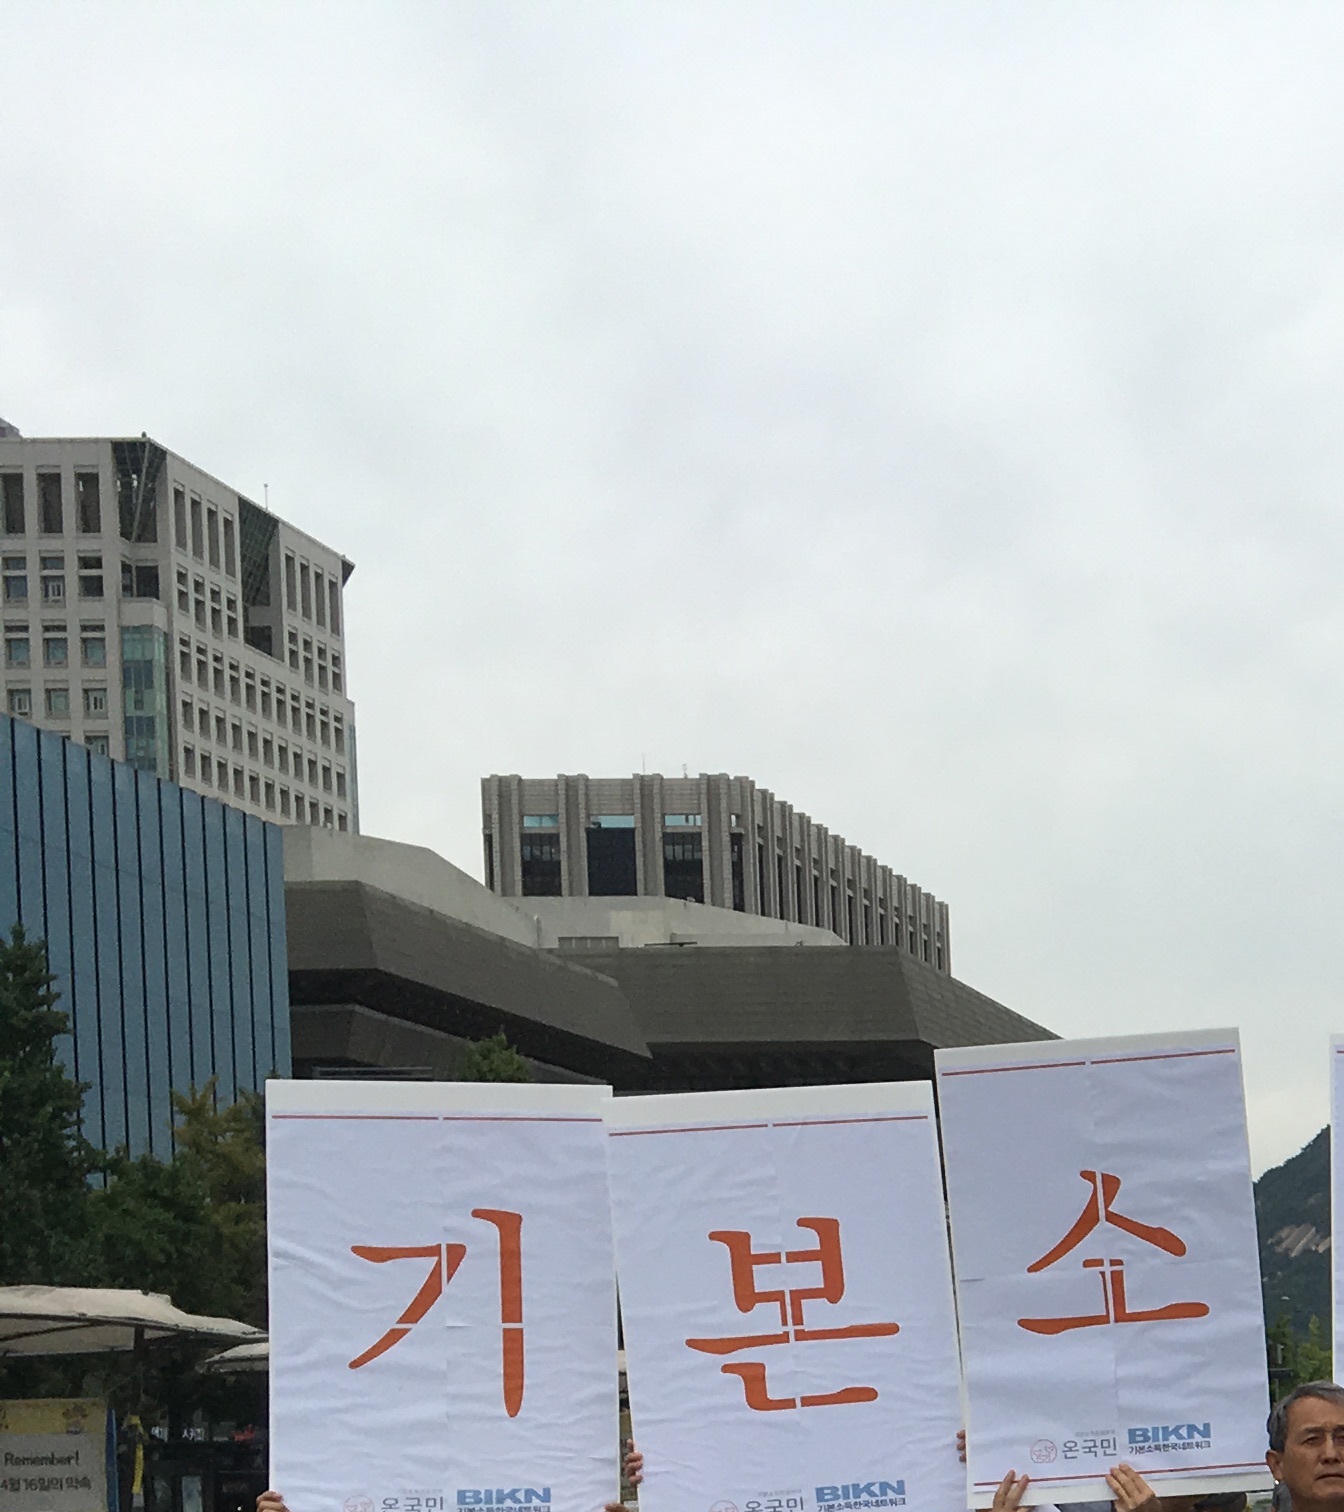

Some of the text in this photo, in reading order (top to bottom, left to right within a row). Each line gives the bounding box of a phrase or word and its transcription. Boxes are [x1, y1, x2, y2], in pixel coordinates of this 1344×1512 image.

[1017, 1170, 1210, 1335] 소
[352, 1208, 524, 1417] 기
[685, 1217, 900, 1412] 본
[1127, 1422, 1211, 1445] BIKN
[4, 1450, 79, 1466] Remember!
[1062, 1437, 1118, 1460] 온국민
[1129, 1440, 1212, 1455] 기본소득한국네트워크
[456, 1487, 552, 1506] BIKN
[815, 1480, 905, 1503] BIKN
[818, 1498, 907, 1512] 기본소득한국네트워크
